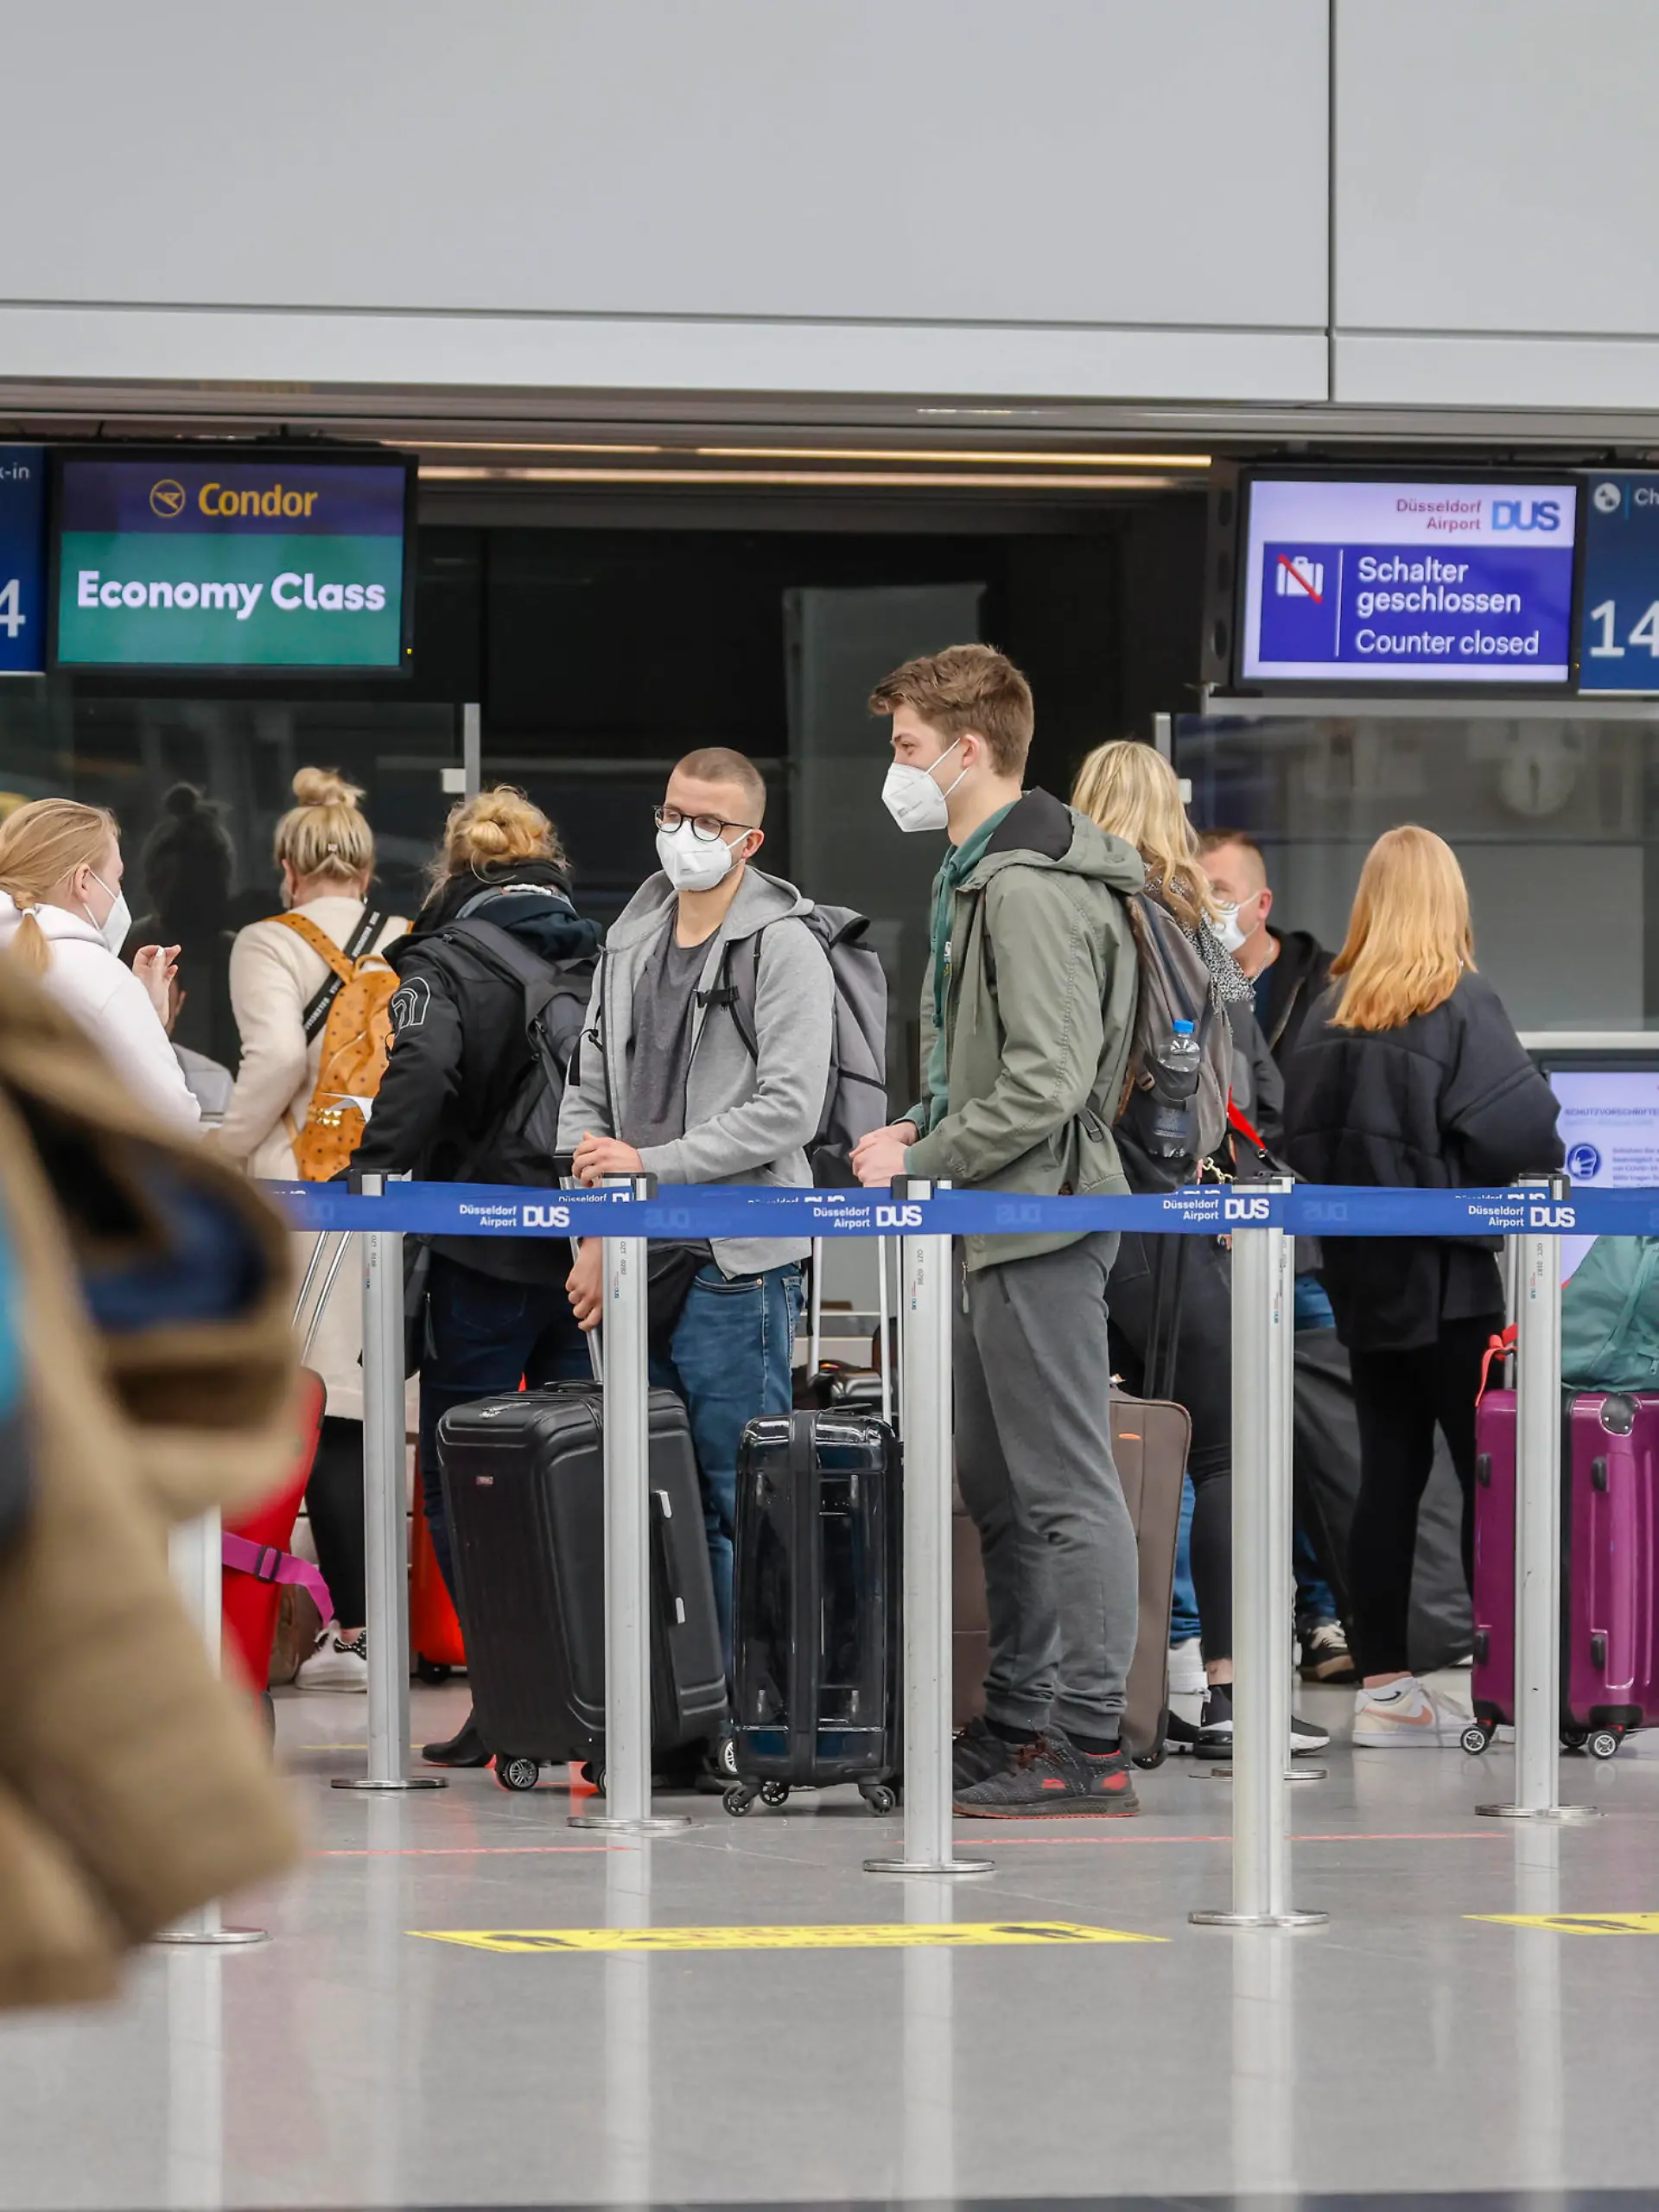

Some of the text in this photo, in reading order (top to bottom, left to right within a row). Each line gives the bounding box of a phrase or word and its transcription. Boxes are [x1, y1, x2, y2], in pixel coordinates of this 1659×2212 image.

[198, 483, 318, 517] Condor
[1395, 499, 1482, 513] Düsseldorf
[1427, 518, 1481, 532] Airport
[1491, 499, 1560, 531] DUS
[1357, 555, 1469, 583] Schalter
[78, 570, 386, 620] Economy Class
[1357, 585, 1522, 619] geschlossen
[1590, 599, 1659, 658] 14
[1355, 629, 1539, 656] Counter closed
[460, 1205, 517, 1215] Düsseldorf
[813, 1206, 869, 1217] Düsseldorf
[1163, 1199, 1218, 1210] Düsseldorf
[1224, 1198, 1269, 1219] DUS
[1469, 1205, 1524, 1216] Düsseldorf
[480, 1217, 517, 1228] Airport
[523, 1205, 570, 1228] DUS
[834, 1218, 871, 1230] Airport
[875, 1205, 923, 1227] DUS
[1183, 1211, 1218, 1222] Airport
[1489, 1217, 1524, 1228] Airport
[1530, 1206, 1575, 1228] DUS
